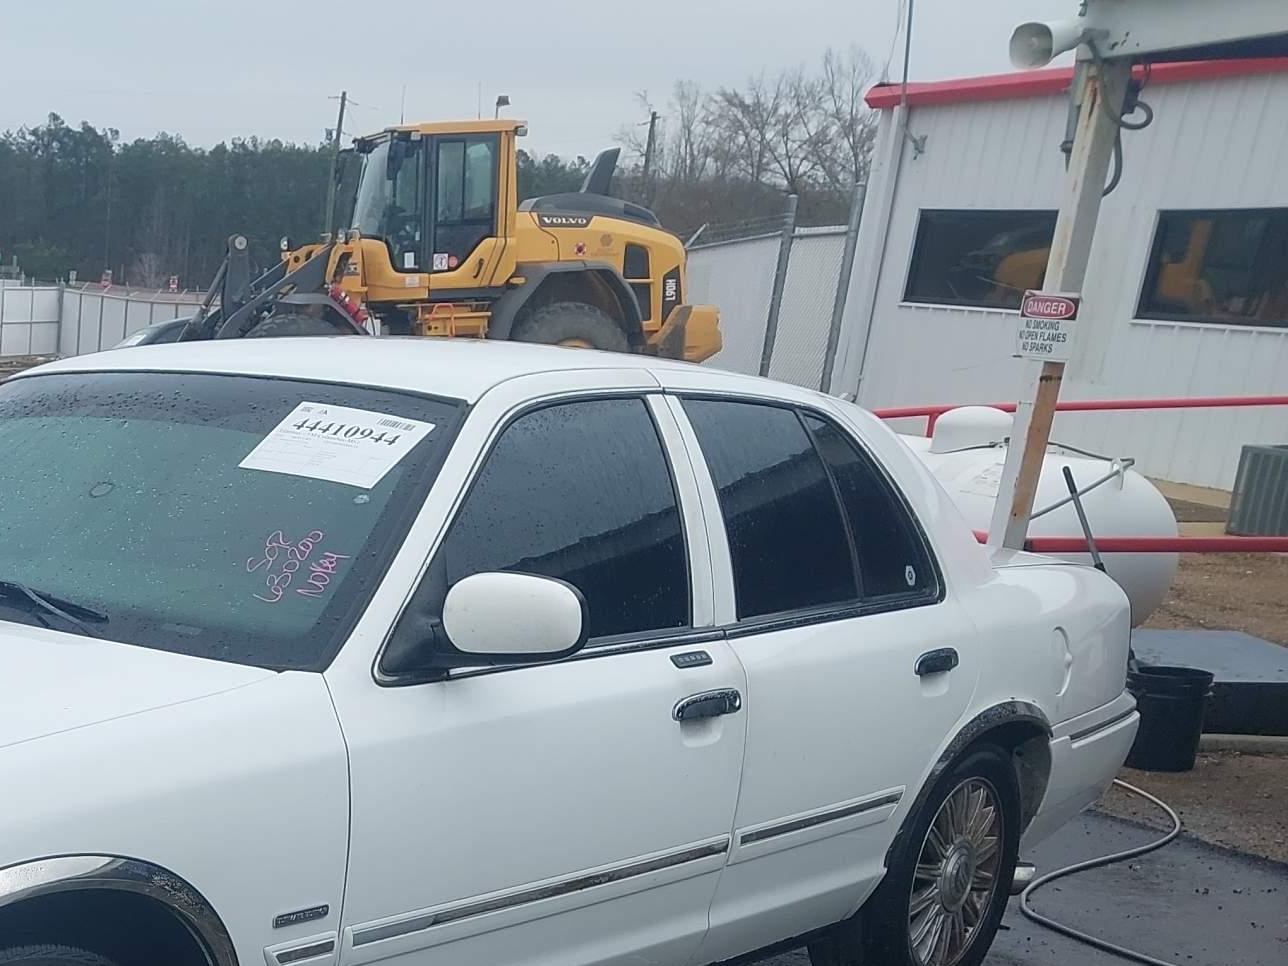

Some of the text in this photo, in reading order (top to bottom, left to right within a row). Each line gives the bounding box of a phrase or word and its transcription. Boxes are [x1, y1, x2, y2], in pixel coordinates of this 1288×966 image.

[542, 216, 587, 225] VOLVO
[665, 279, 677, 301] L90H
[1027, 300, 1067, 315] DANGER
[1032, 319, 1060, 331] SMOKING
[1025, 330, 1039, 341] OPEN
[1039, 331, 1067, 343] FLAMES
[1029, 341, 1053, 353] SPARKS
[292, 418, 402, 446] 44410944
